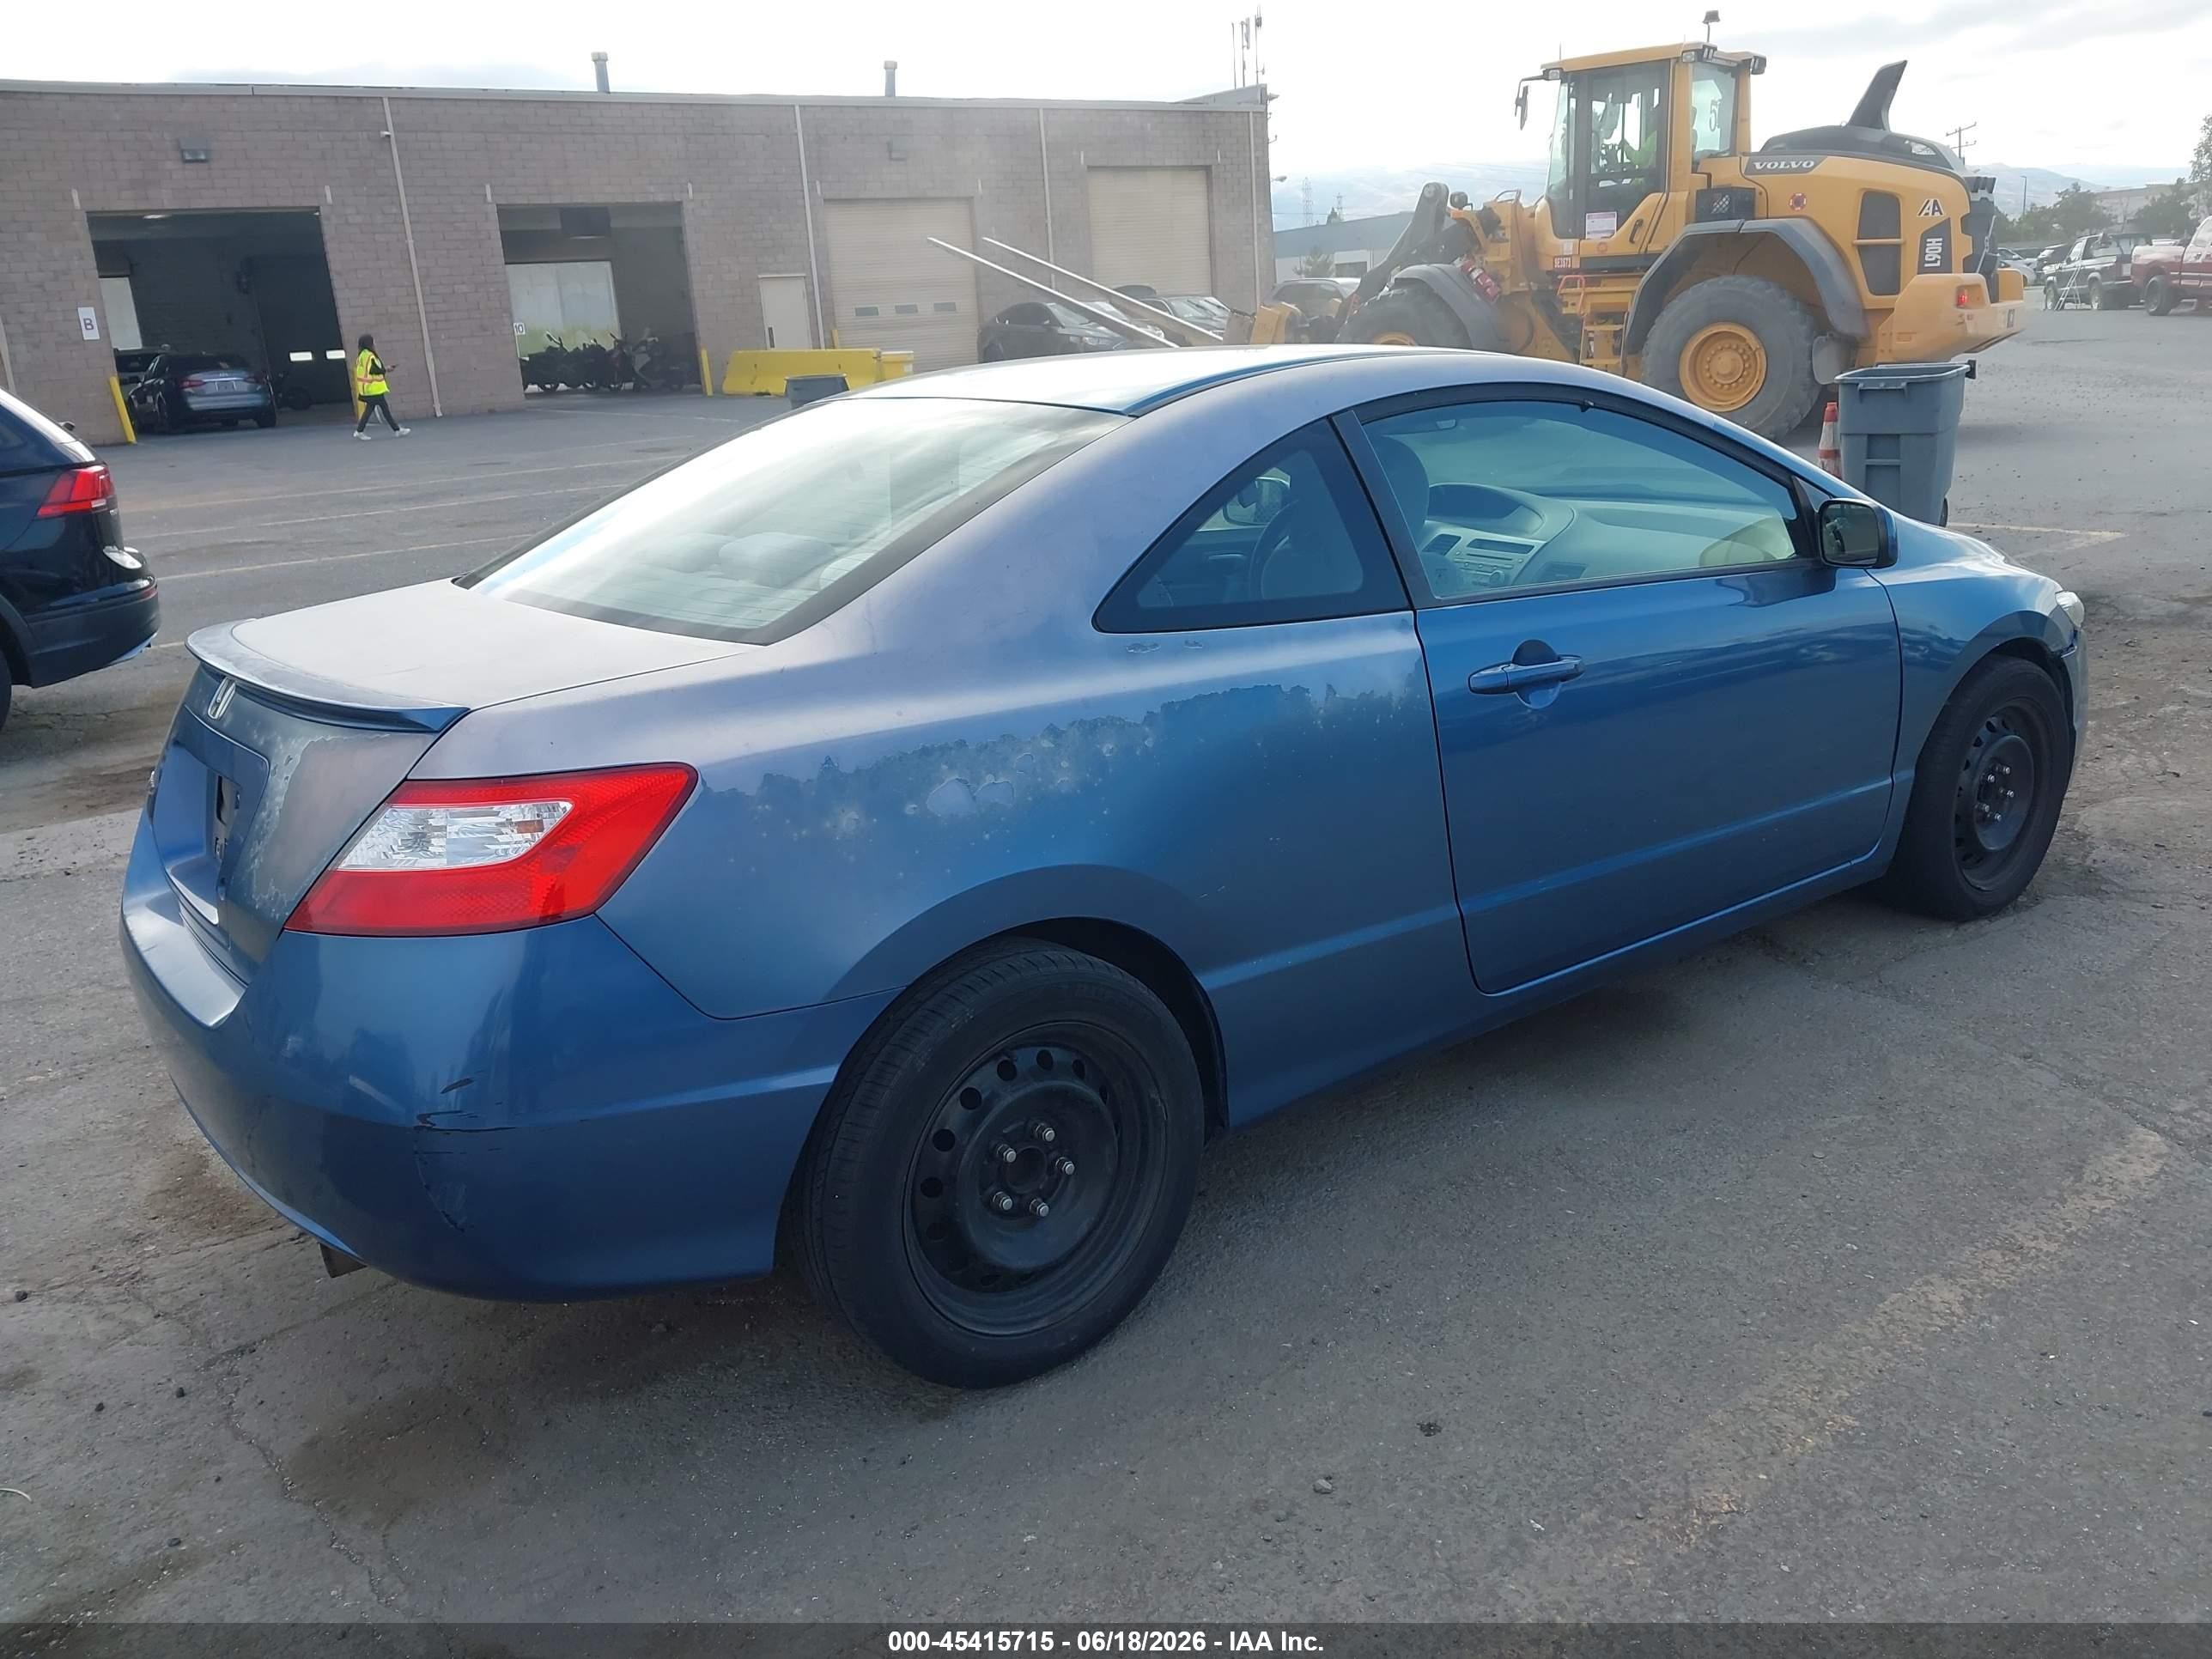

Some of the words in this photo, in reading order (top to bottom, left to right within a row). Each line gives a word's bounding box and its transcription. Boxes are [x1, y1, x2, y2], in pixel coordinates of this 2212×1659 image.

[1753, 161, 1814, 171] VOLVO
[1924, 238, 1943, 267] L90H
[82, 318, 94, 331] B
[514, 324, 524, 334] 10
